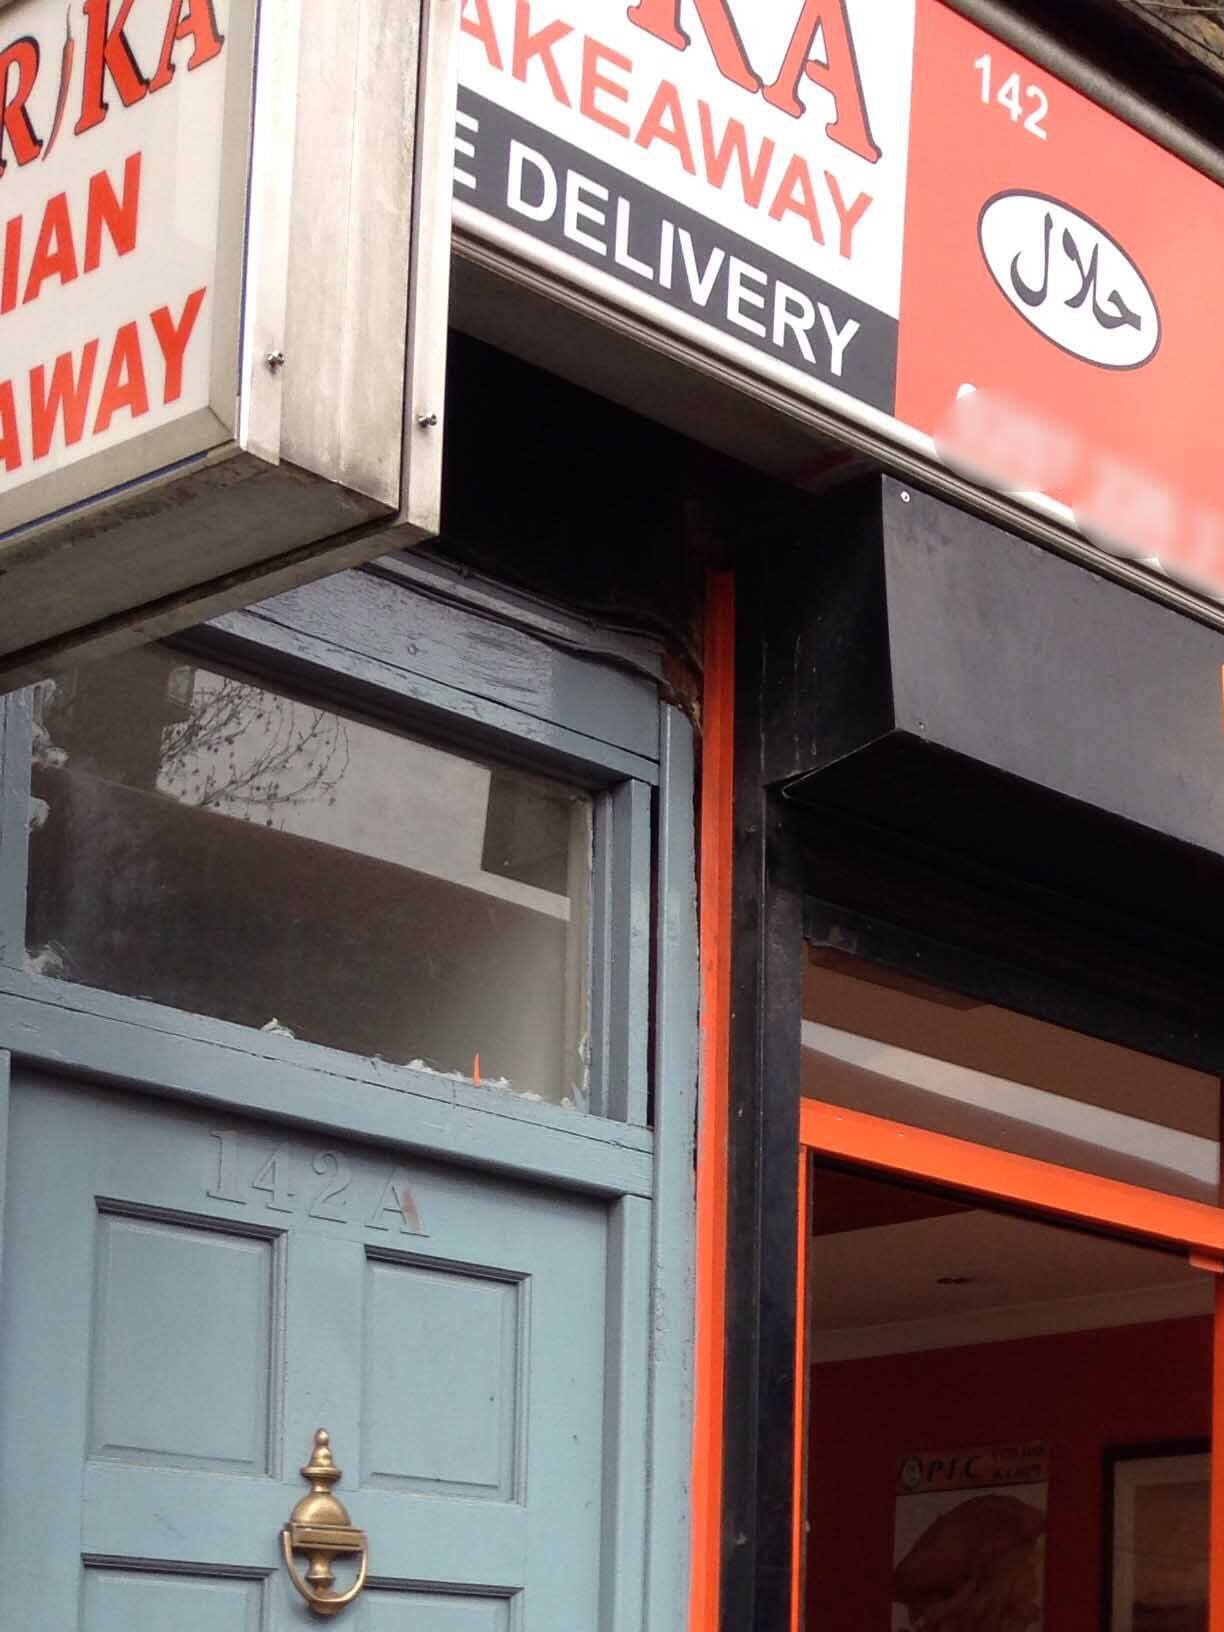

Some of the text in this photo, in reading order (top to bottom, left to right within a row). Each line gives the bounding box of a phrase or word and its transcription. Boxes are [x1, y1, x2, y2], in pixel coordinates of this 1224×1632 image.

[973, 53, 1050, 141] 142
[506, 138, 861, 377] DELIVERY
[1009, 210, 1142, 332] حلال
[206, 1129, 430, 1238] 142A
